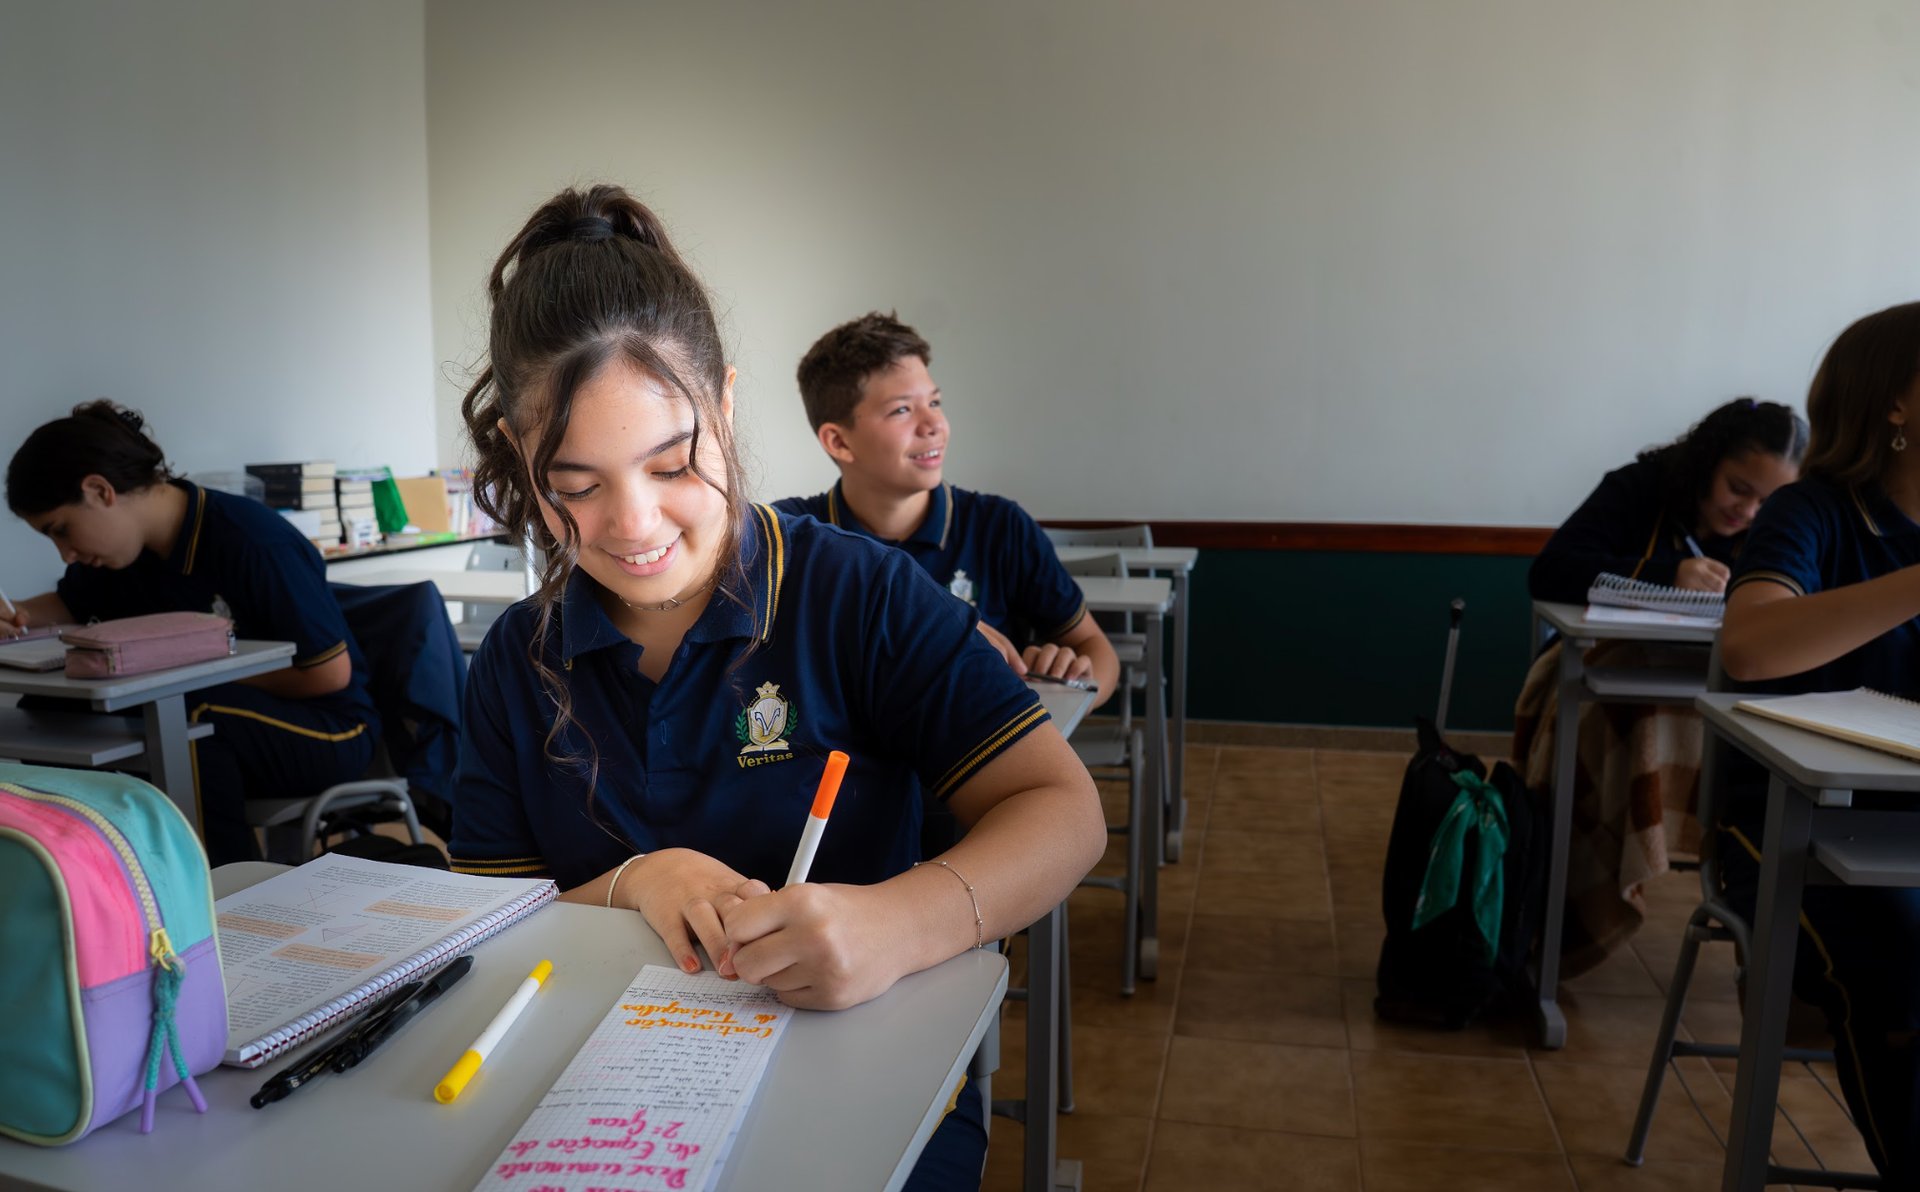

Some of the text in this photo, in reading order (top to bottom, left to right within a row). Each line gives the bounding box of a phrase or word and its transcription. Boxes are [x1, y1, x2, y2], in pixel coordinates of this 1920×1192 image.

[736, 752, 794, 769] Veritas
[620, 1001, 737, 1024] Triângulos
[626, 1018, 773, 1038] Continuação
[546, 1135, 655, 1160] Equação
